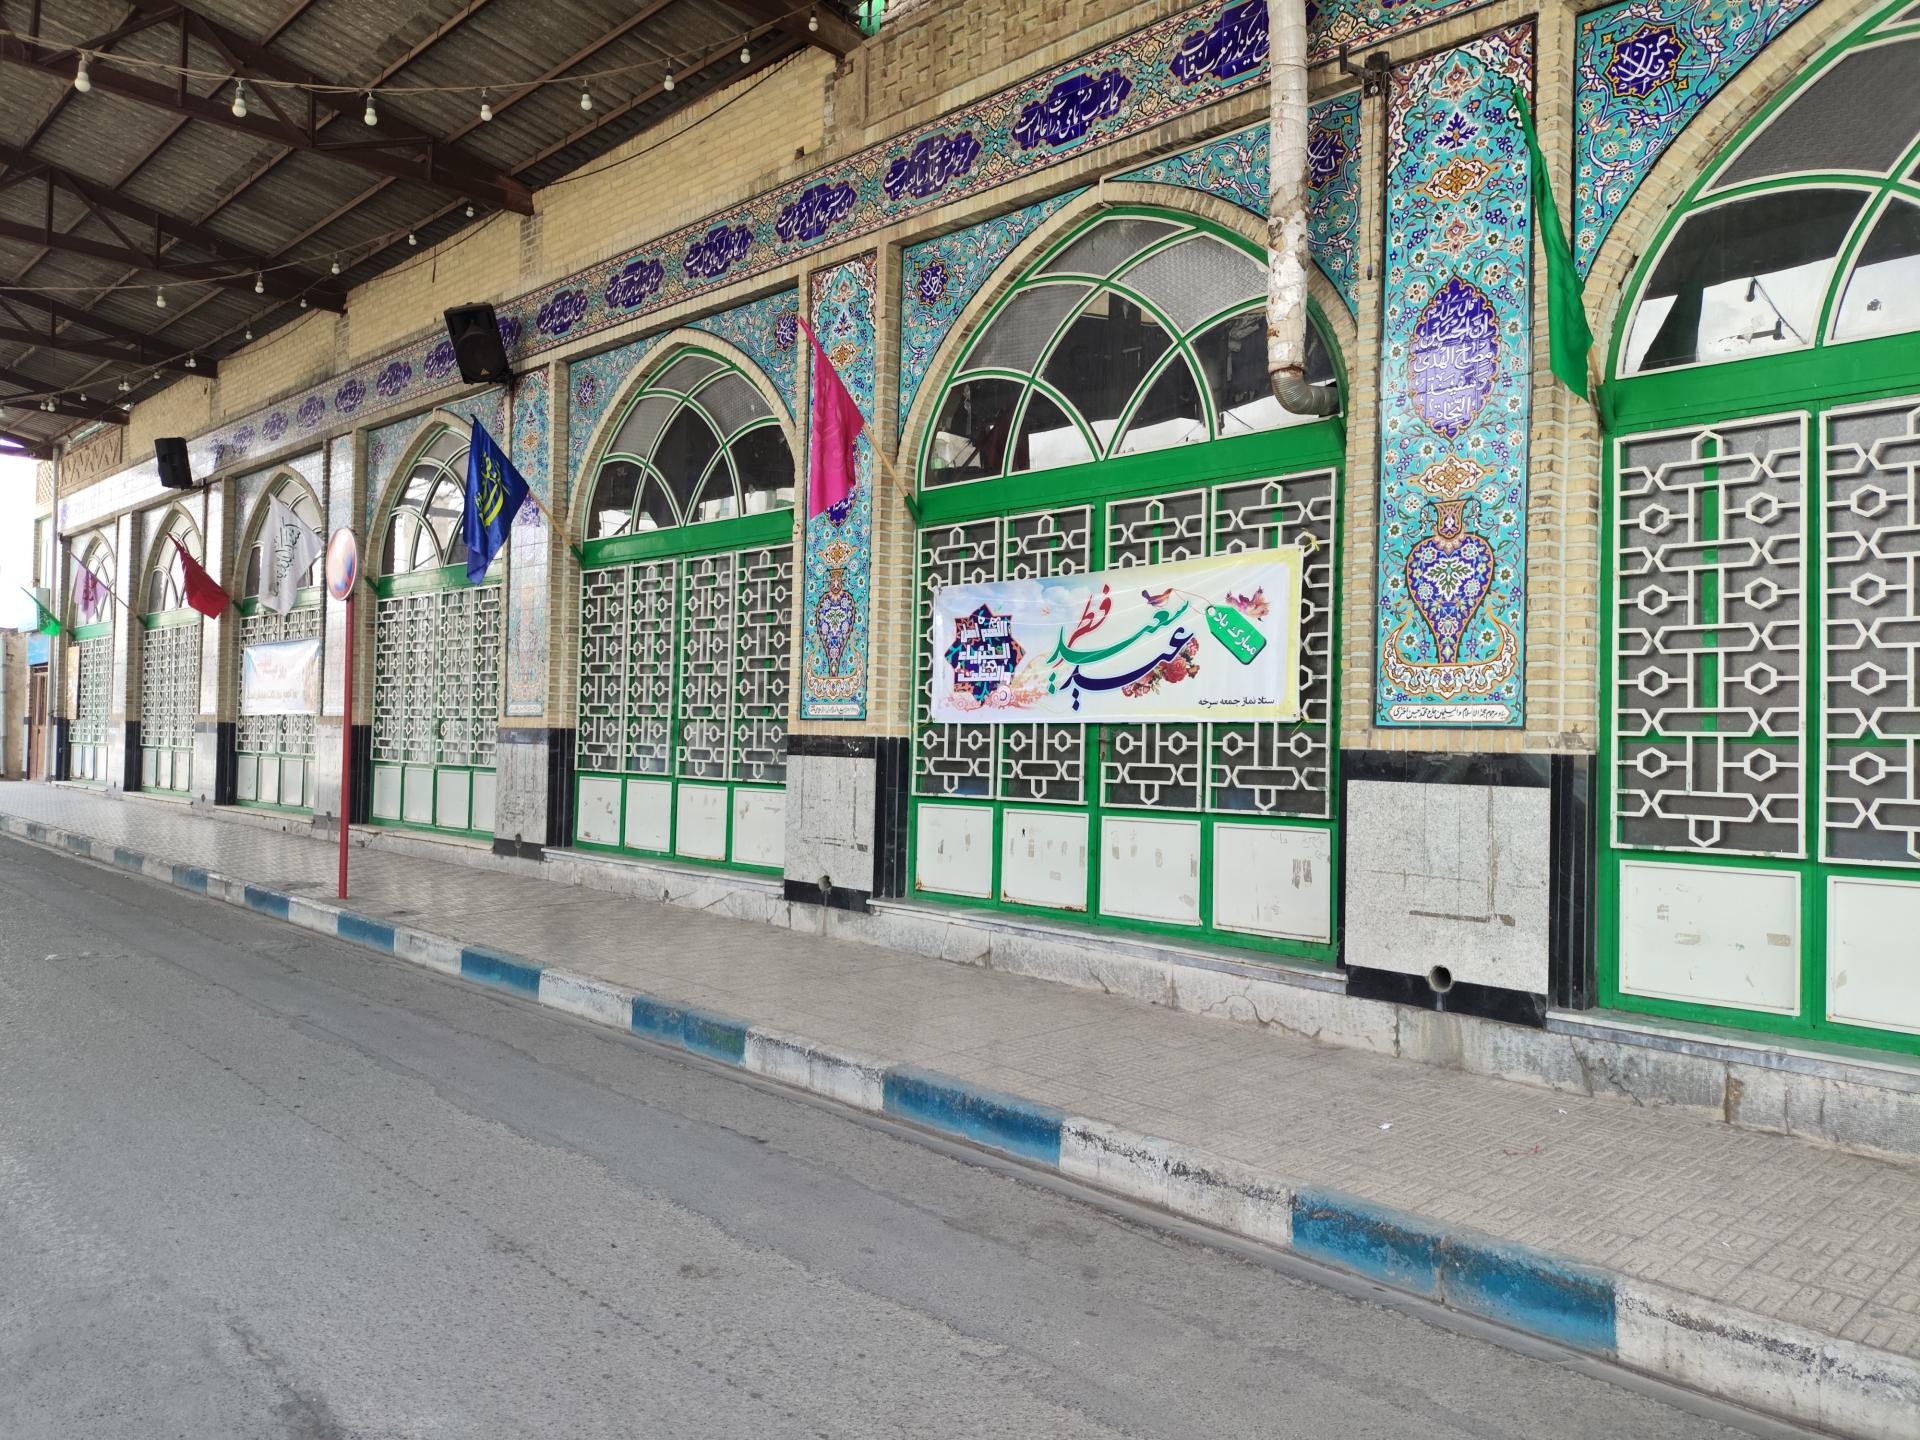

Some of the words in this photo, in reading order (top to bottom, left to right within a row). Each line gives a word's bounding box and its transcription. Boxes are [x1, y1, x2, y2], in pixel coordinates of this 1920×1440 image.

[1052, 584, 1112, 669] فطر
[1213, 612, 1229, 630] باد
[1047, 600, 1189, 695] سعید
[1227, 626, 1256, 655] مبارک
[1059, 626, 1194, 712] عید
[1198, 697, 1218, 708] سرخه
[1242, 696, 1257, 706] نماز
[1258, 696, 1275, 705] ستاد
